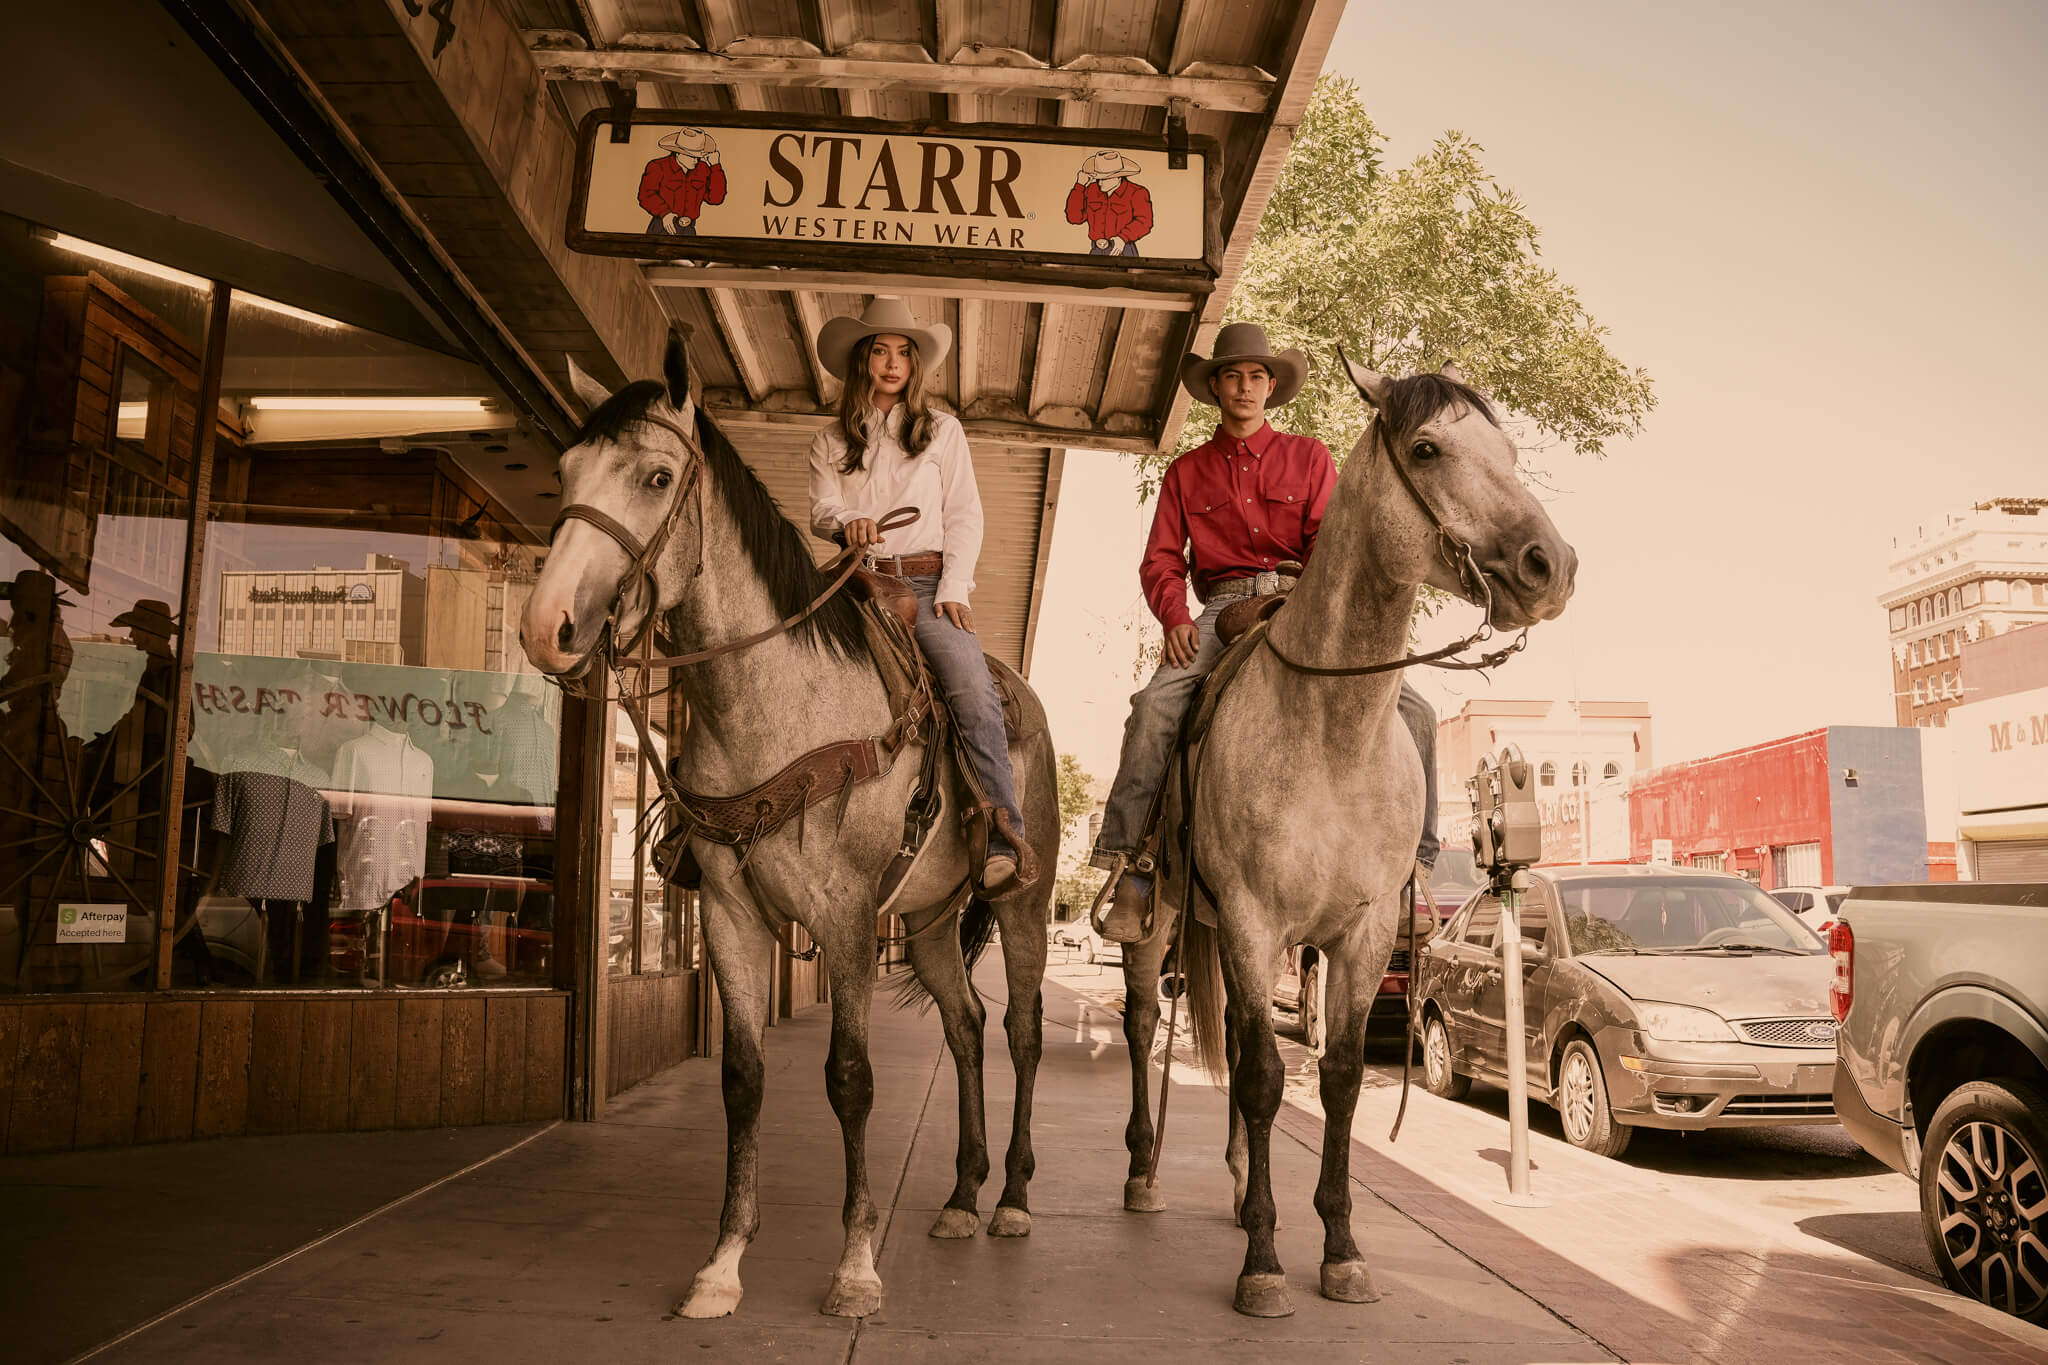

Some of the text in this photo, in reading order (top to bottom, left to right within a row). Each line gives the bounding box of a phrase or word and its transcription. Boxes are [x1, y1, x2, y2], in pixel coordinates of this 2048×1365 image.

[763, 133, 1026, 219] STARR
[762, 215, 1025, 249] WESTERN WEAR
[81, 911, 125, 922] Afterpay
[59, 929, 101, 938] Accepted
